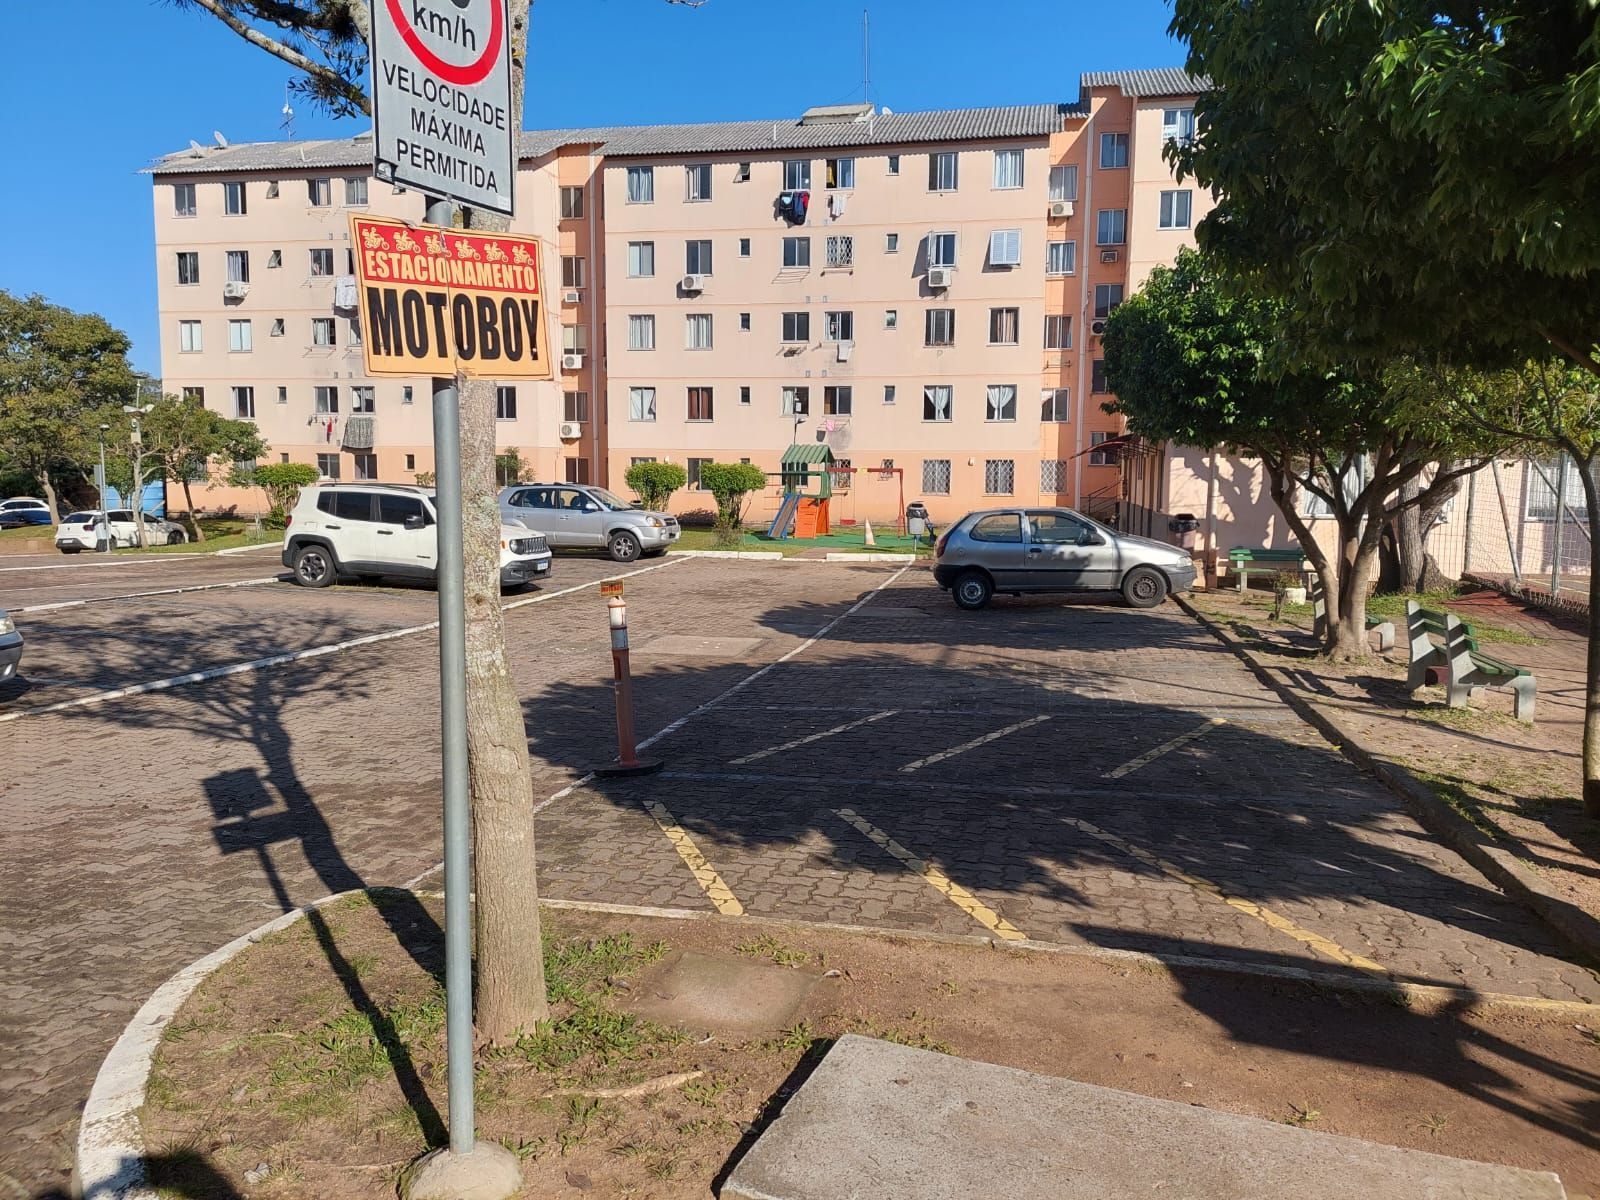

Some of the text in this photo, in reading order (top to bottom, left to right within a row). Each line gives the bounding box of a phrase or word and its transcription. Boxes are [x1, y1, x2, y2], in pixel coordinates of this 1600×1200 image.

[412, 0, 476, 51] km/h
[382, 60, 505, 131] VELOCIDADE
[411, 108, 486, 156] MÁXIMA
[396, 138, 499, 193] PERMITIDA
[365, 250, 536, 291] ESTACIONAMENTO
[367, 287, 539, 362] MOTOBOY
